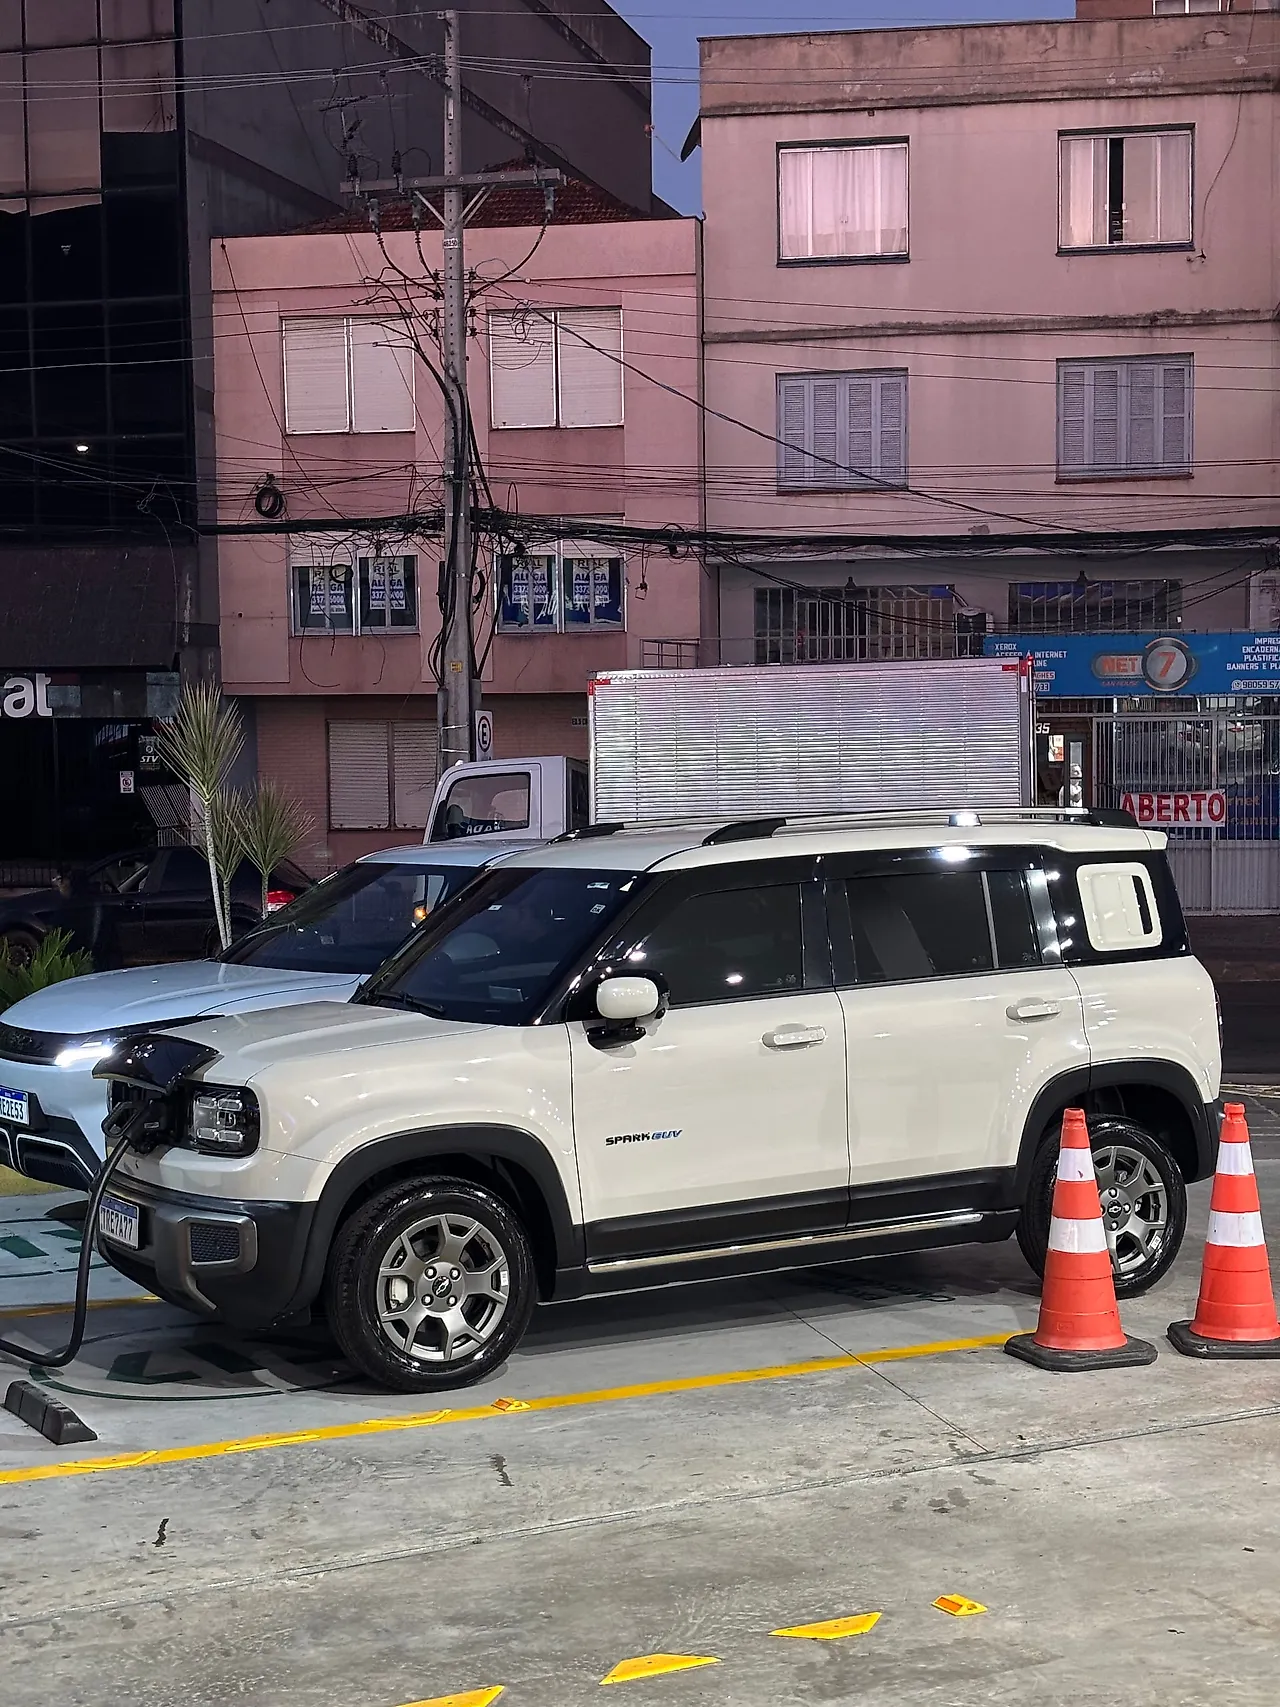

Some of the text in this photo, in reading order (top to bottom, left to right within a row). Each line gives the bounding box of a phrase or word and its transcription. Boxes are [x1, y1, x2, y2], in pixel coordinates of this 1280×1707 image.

[1102, 652, 1176, 678] NET 7
[0, 673, 52, 717] at
[481, 723, 488, 745] E
[140, 755, 159, 763] STV
[1121, 793, 1224, 822] ABERTO
[605, 1132, 650, 1146] SPARK
